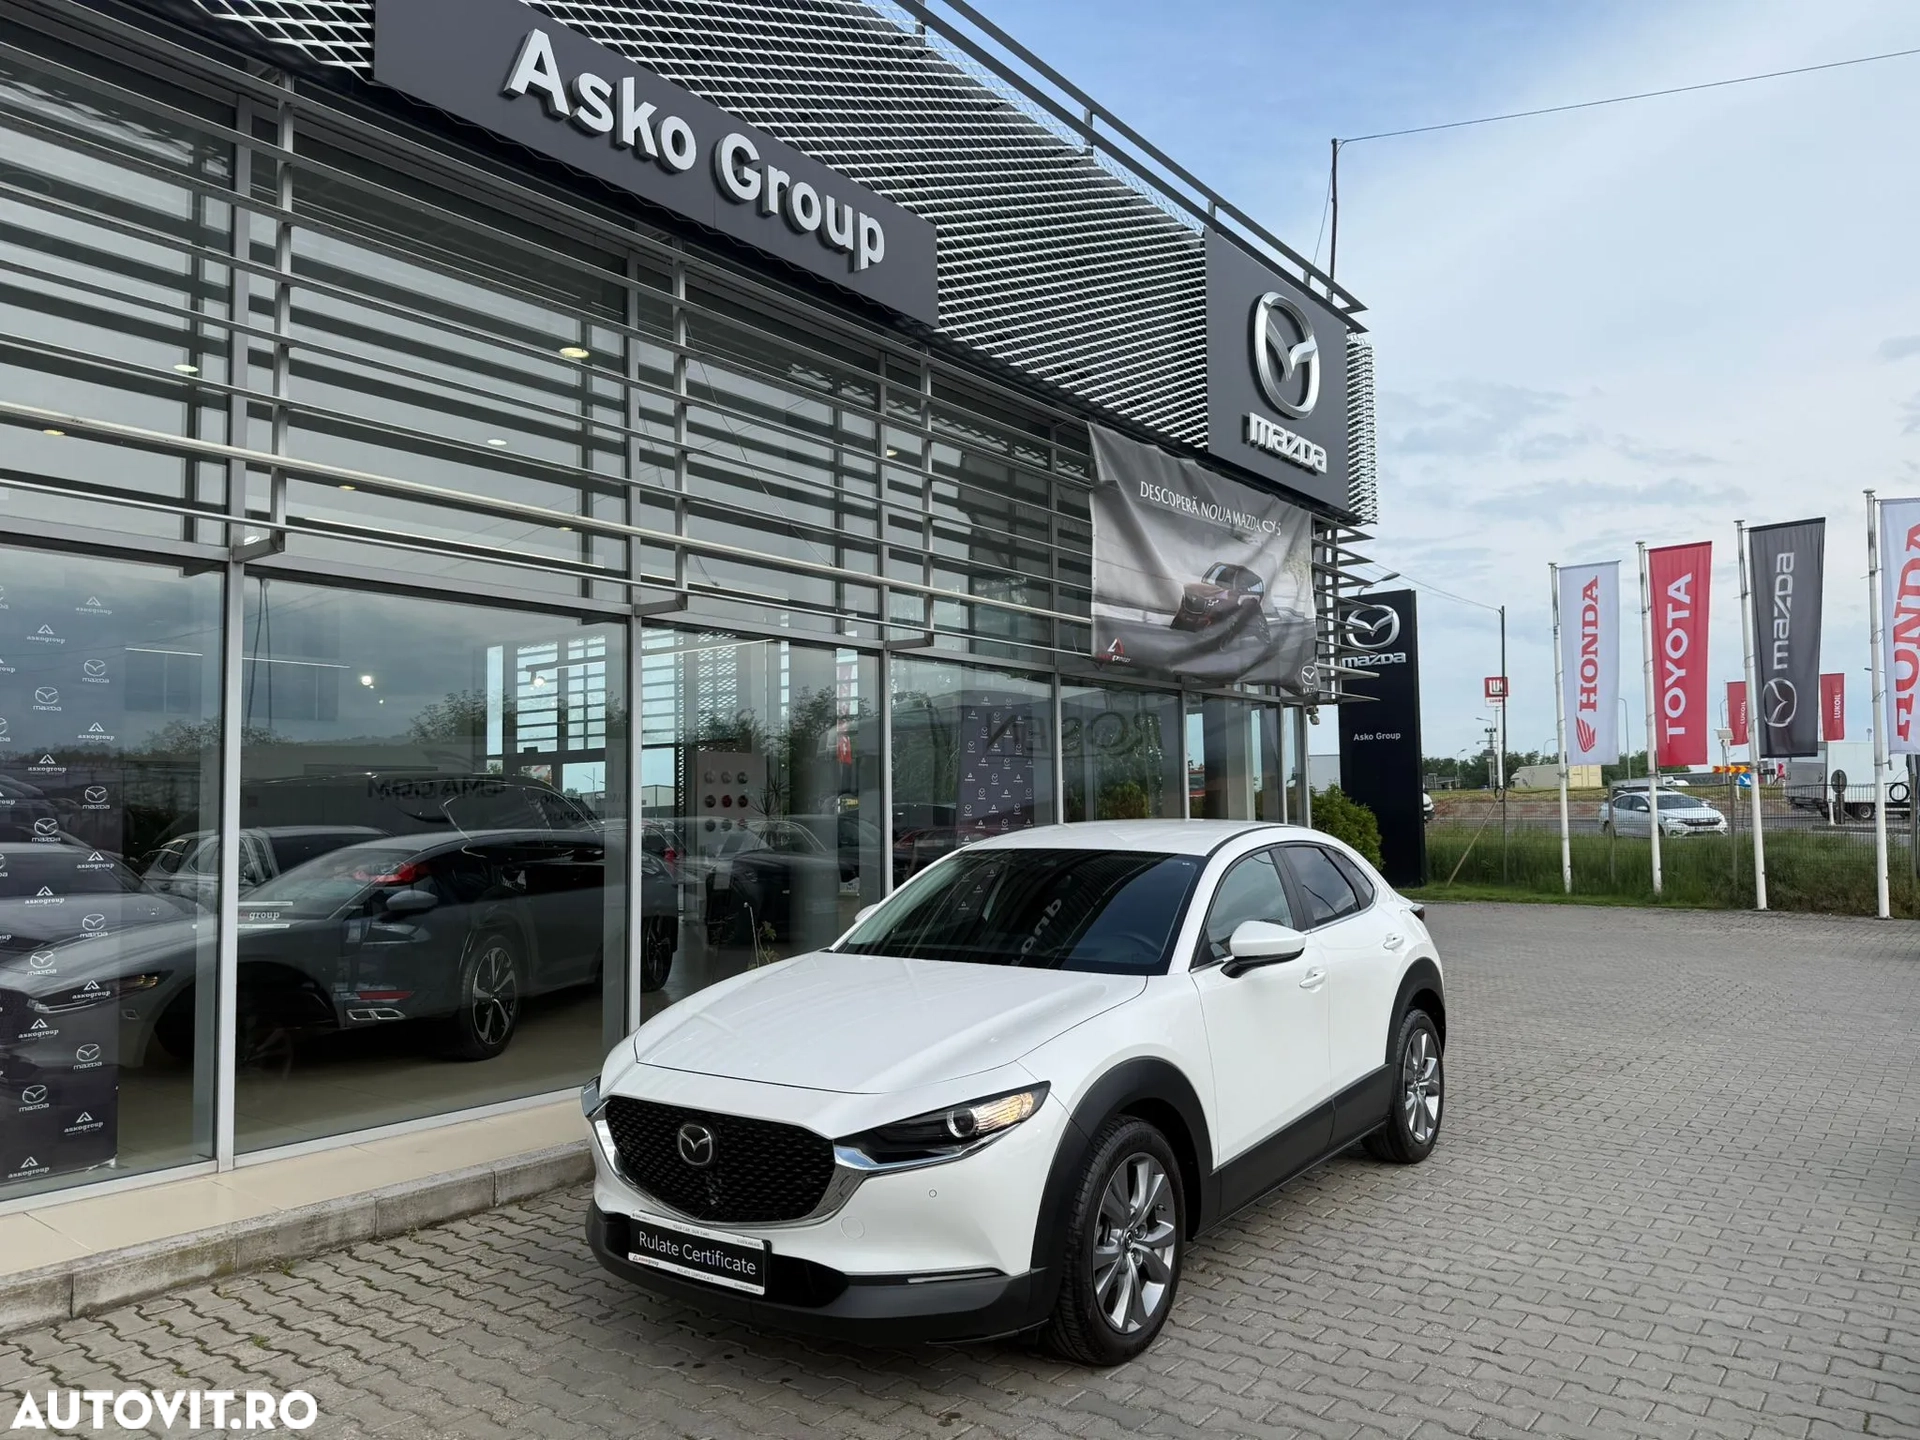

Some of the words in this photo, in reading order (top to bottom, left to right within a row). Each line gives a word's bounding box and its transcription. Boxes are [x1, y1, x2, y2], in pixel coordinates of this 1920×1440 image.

[502, 28, 697, 173] Asko
[716, 132, 886, 272] Group
[1248, 412, 1327, 474] mazda
[1140, 481, 1199, 516] DESCOPERĂ
[1200, 501, 1232, 523] NOUA
[1232, 510, 1262, 533] MAZDA
[1772, 551, 1795, 671] mazda
[1341, 652, 1407, 668] mazda
[1579, 575, 1599, 713] HONDA
[1664, 572, 1693, 743] TOYOTA
[1353, 732, 1374, 741] Asko
[1375, 732, 1401, 740] Group
[639, 1231, 679, 1256] Rulate
[682, 1243, 756, 1275] Certificate
